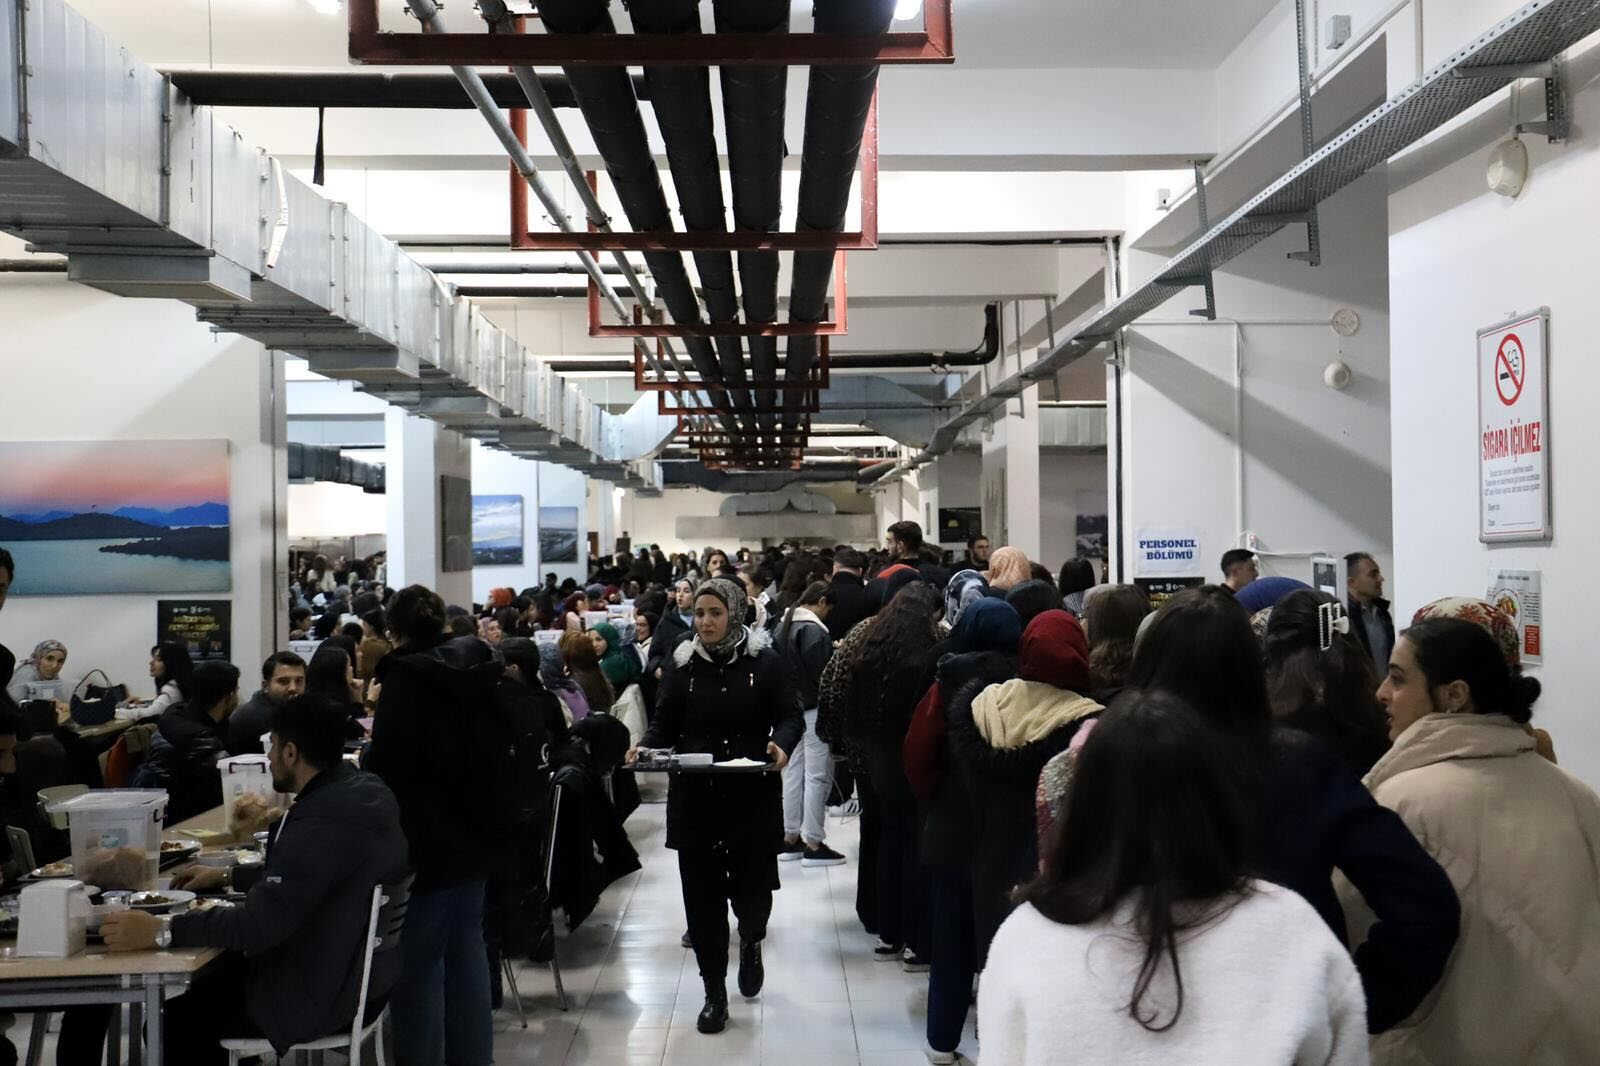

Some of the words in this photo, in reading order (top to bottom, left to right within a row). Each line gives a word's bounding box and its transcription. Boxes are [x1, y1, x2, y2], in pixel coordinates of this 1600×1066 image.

[1483, 424, 1509, 461] SİGARA
[1510, 418, 1541, 463] İÇİLMEZ
[1139, 539, 1197, 549] PERSONEL
[1146, 549, 1193, 560] BÖLÜMÜ
